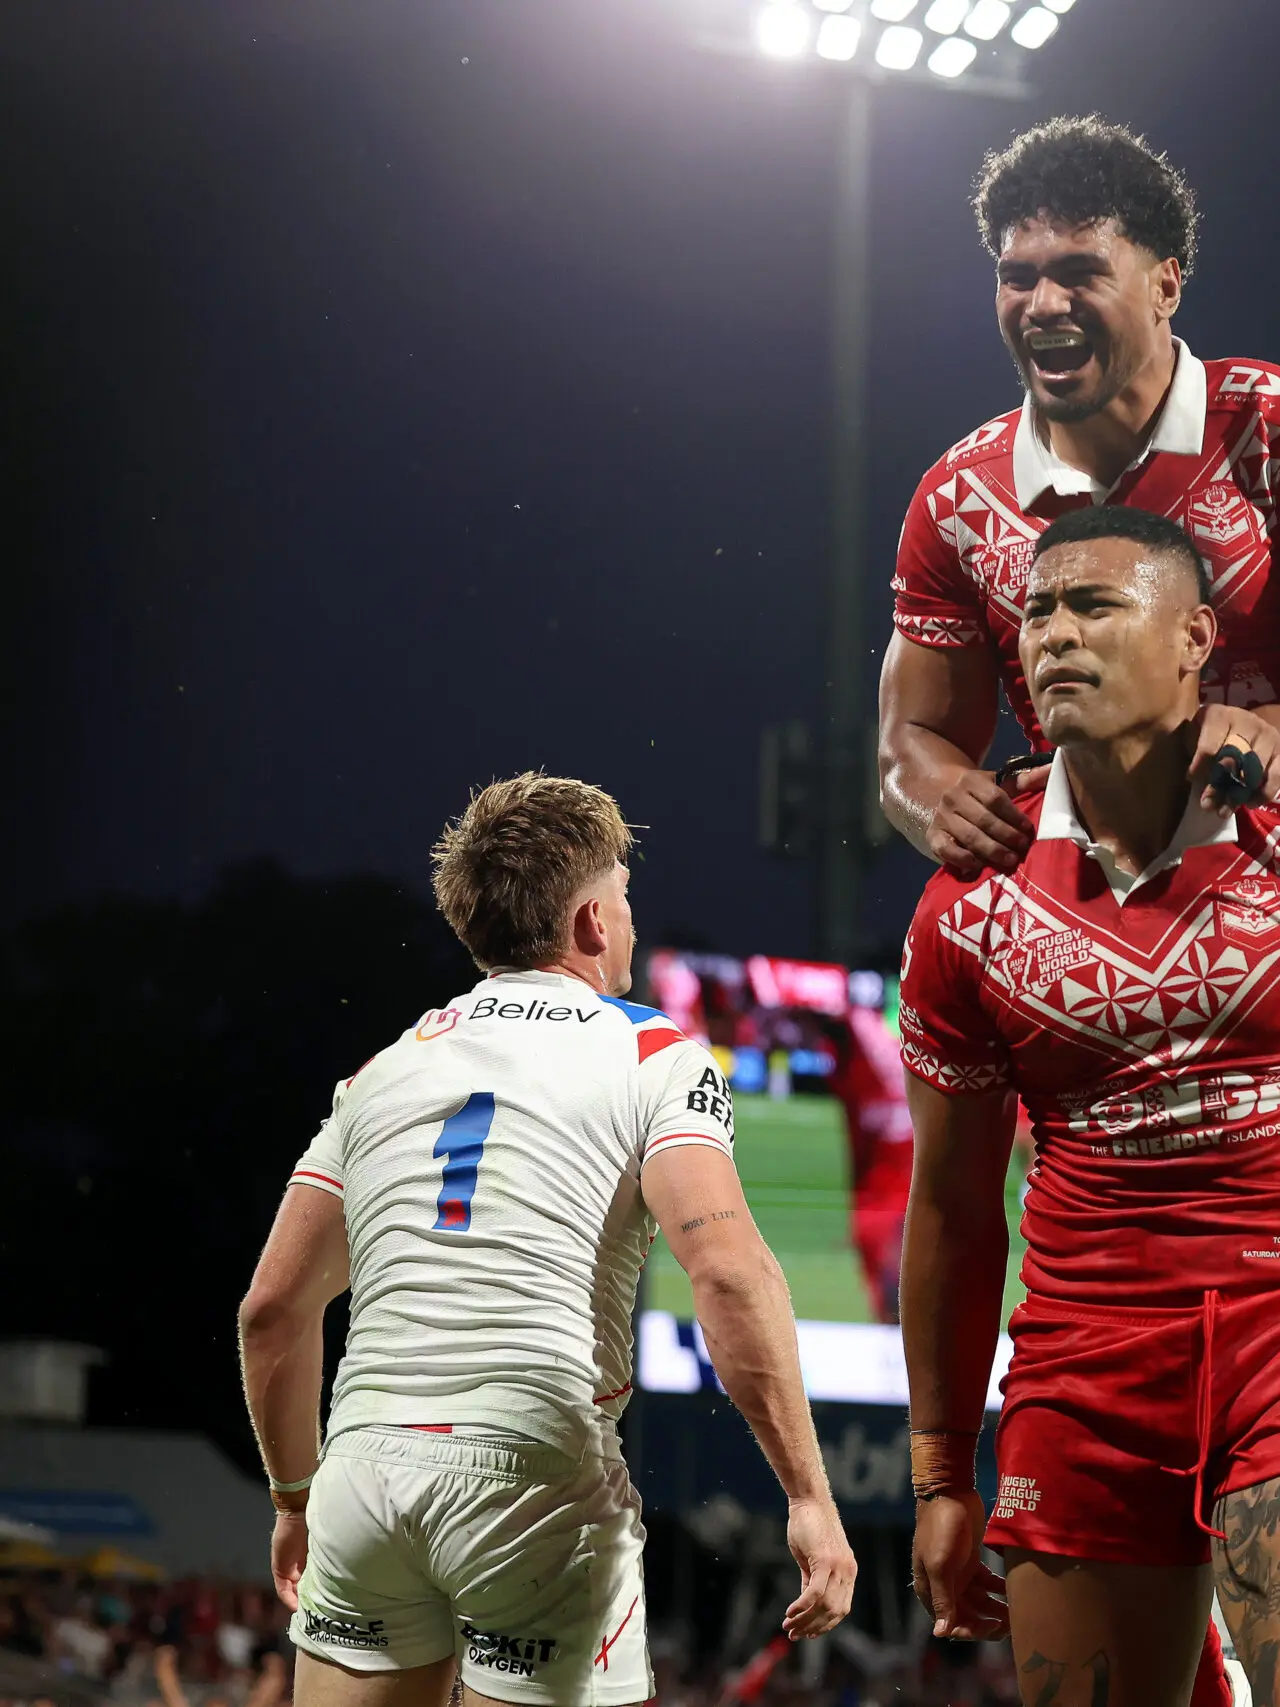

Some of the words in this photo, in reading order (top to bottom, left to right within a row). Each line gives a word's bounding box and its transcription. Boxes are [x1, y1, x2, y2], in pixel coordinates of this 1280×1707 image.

[1009, 540, 1036, 556] RUG
[1009, 551, 1035, 568] LEA
[1009, 574, 1028, 589] CU
[1037, 928, 1082, 951] RUGBY
[1037, 937, 1091, 963] LEAGUE
[1010, 956, 1025, 969] AUS
[1039, 949, 1088, 974] WORLD
[1039, 968, 1065, 986] CUP
[469, 998, 601, 1023] Believ
[1091, 1145, 1110, 1157] THE
[1112, 1128, 1224, 1157] FRIENDLY
[432, 1092, 495, 1232] 1
[681, 1216, 705, 1234] MORE
[711, 1210, 737, 1222] LIFE
[1242, 1250, 1280, 1258] SATURDAY
[1000, 1486, 1041, 1501] LEAGUE
[996, 1507, 1015, 1518] CUP
[999, 1497, 1037, 1511] WORLD
[469, 1646, 535, 1677] OXYGEN
